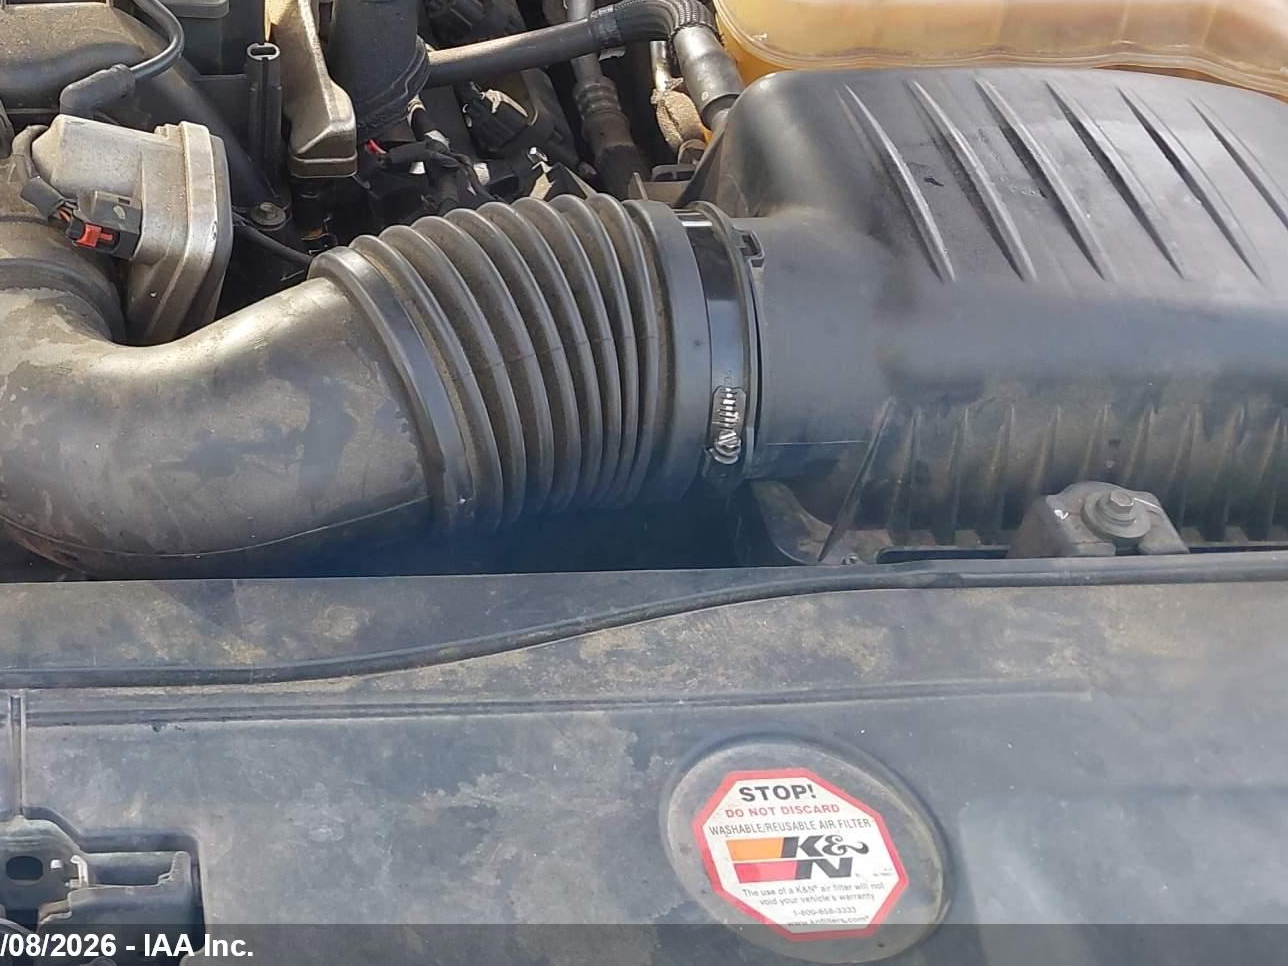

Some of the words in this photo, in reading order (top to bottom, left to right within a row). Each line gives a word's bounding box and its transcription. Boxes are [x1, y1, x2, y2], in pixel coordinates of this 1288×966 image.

[739, 784, 817, 802] STOP!
[725, 809, 744, 818] DO
[749, 807, 777, 817] NOT
[781, 804, 840, 815] DISCARD
[819, 819, 837, 830] AIR
[837, 818, 872, 829] FILTER
[742, 889, 759, 898] The
[778, 886, 787, 895] of
[820, 885, 832, 893] air
[833, 883, 854, 892] filter
[855, 882, 869, 891] will
[870, 881, 886, 890] not
[760, 896, 778, 905] void
[779, 896, 798, 906] your
[839, 892, 875, 903] warranty
